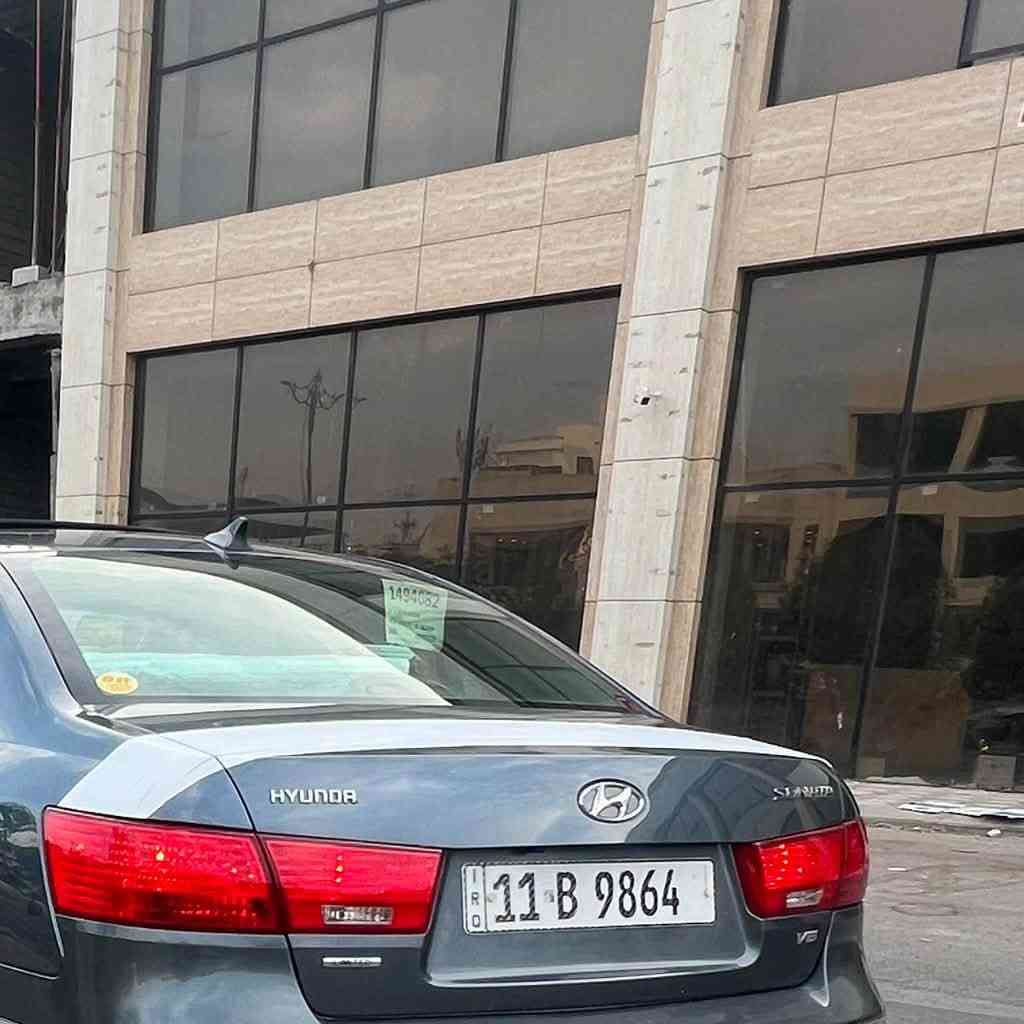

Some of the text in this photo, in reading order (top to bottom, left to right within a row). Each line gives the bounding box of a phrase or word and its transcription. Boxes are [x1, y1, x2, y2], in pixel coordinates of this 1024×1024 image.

[493, 869, 680, 923] 11 B 9864
